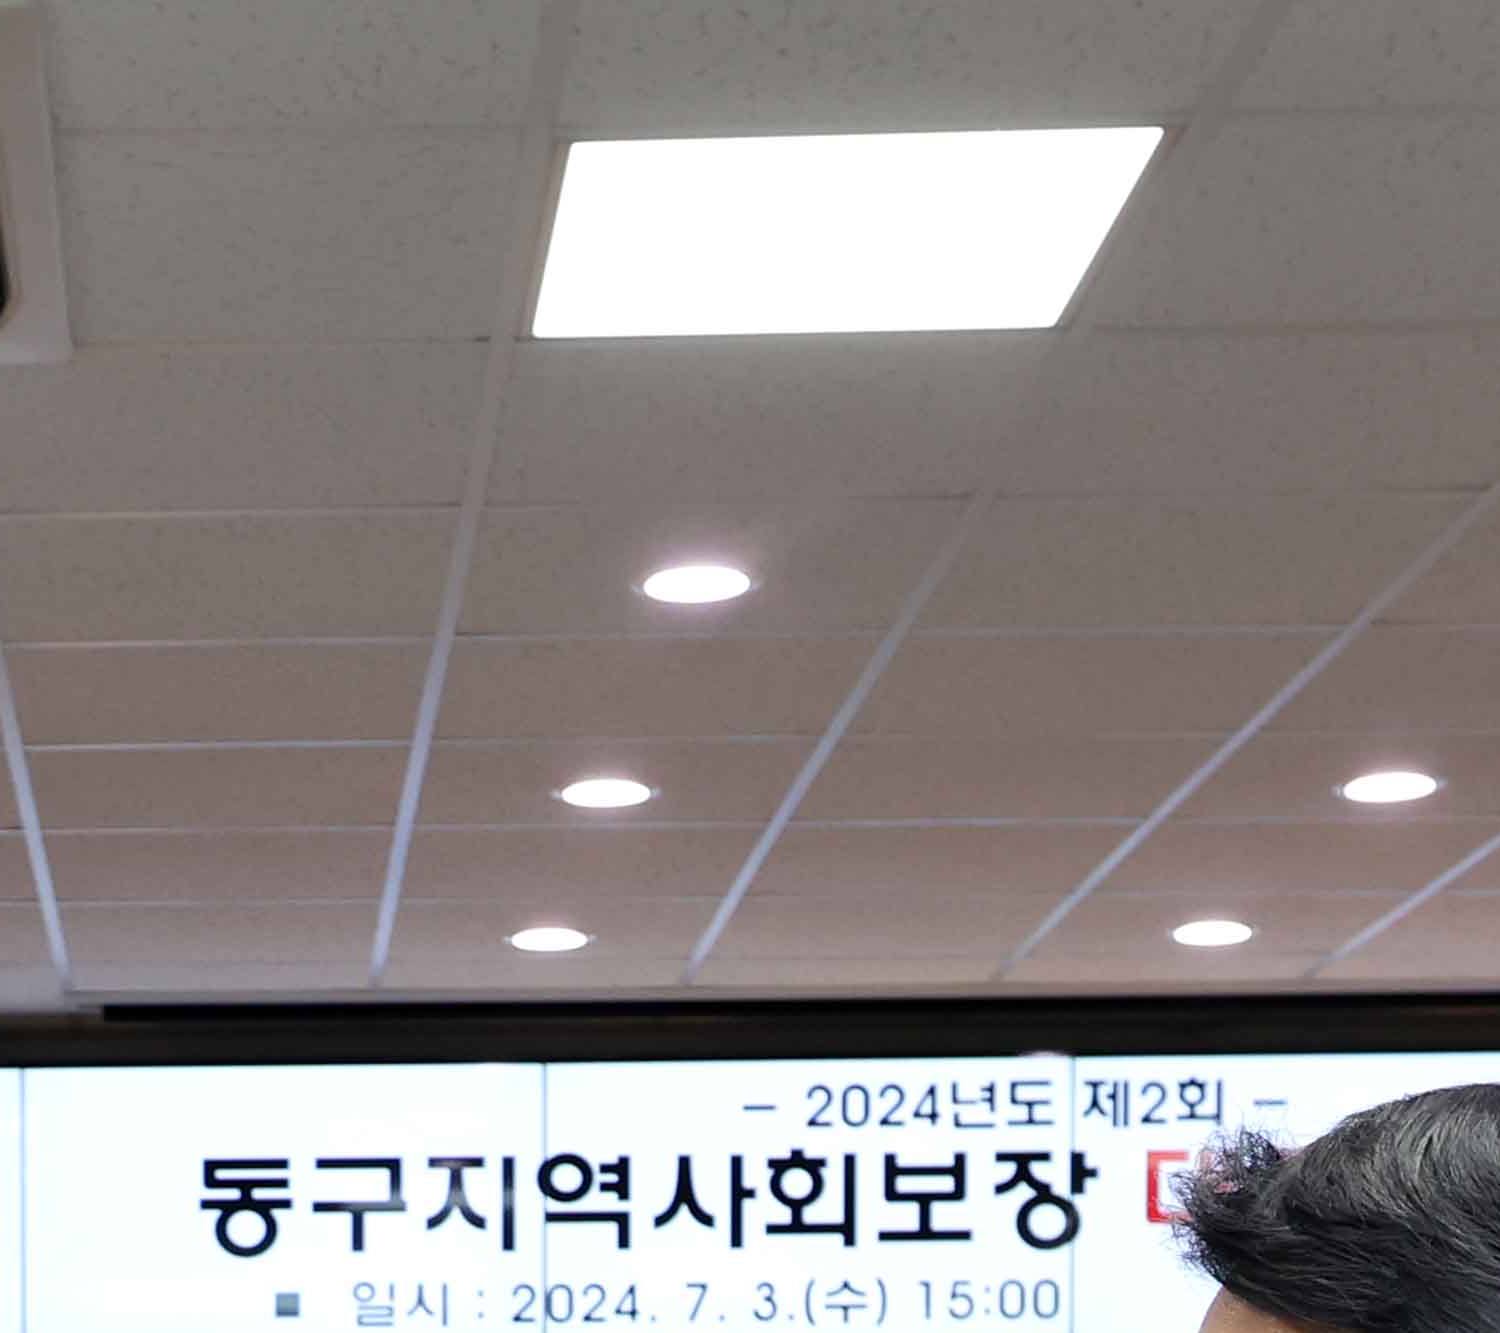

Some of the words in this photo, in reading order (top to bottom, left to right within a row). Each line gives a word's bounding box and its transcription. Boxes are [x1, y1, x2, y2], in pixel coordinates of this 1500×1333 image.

[805, 1080, 1056, 1129] 2024년도
[1083, 1078, 1225, 1128] 제2회
[199, 1147, 1100, 1257] 동구지역사회보장
[352, 1281, 450, 1327] 일시
[511, 1282, 657, 1323] 2024.
[752, 1278, 888, 1327] 3.(수)
[918, 1279, 1062, 1320] 15:00
